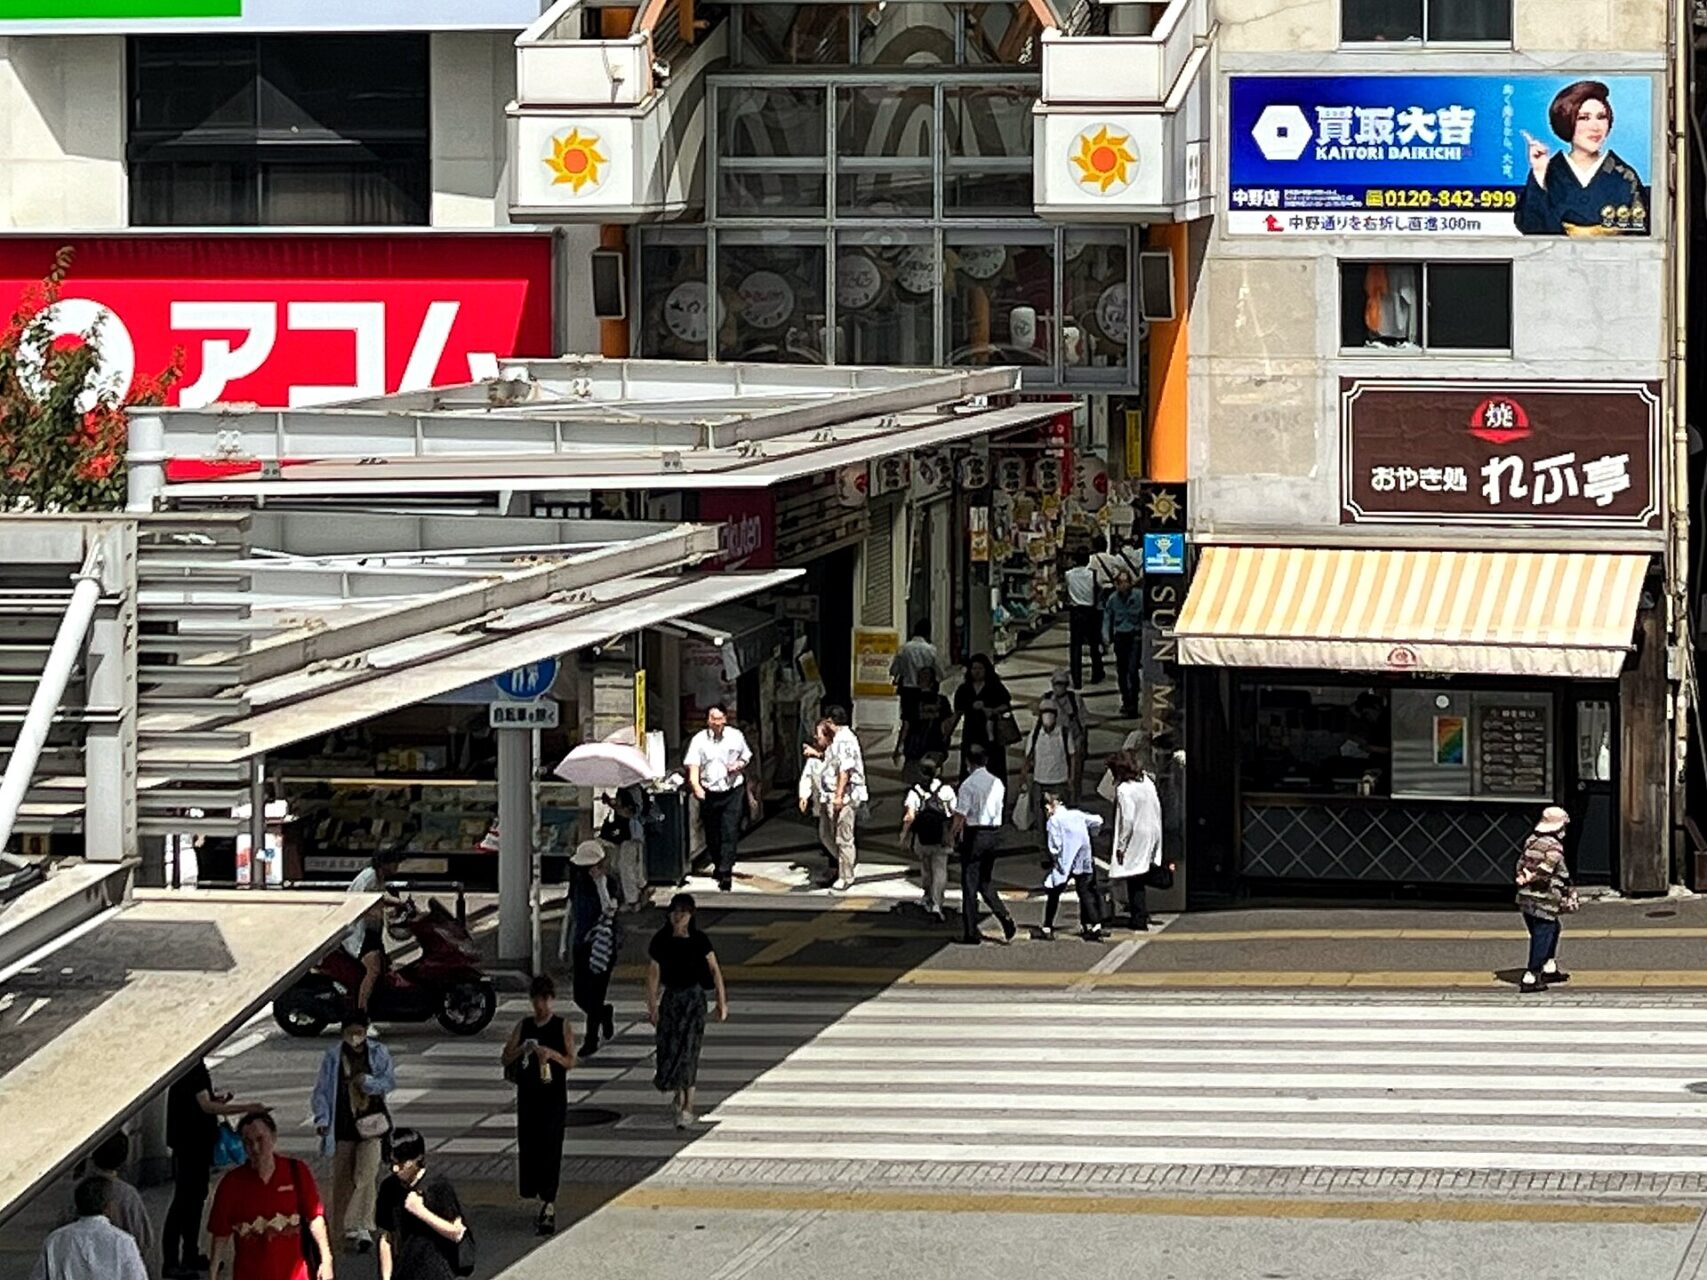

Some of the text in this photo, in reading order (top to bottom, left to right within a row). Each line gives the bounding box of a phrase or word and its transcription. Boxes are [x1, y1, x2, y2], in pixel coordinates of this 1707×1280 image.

[1314, 105, 1477, 146] 買取大吉
[1315, 146, 1463, 161] KAITORI DAIKICHI
[1232, 188, 1281, 208] 中野店
[1384, 190, 1517, 208] 0120-842-999
[169, 301, 501, 410] アコム
[1370, 466, 1468, 493] おやき処
[1151, 585, 1177, 663] SUN
